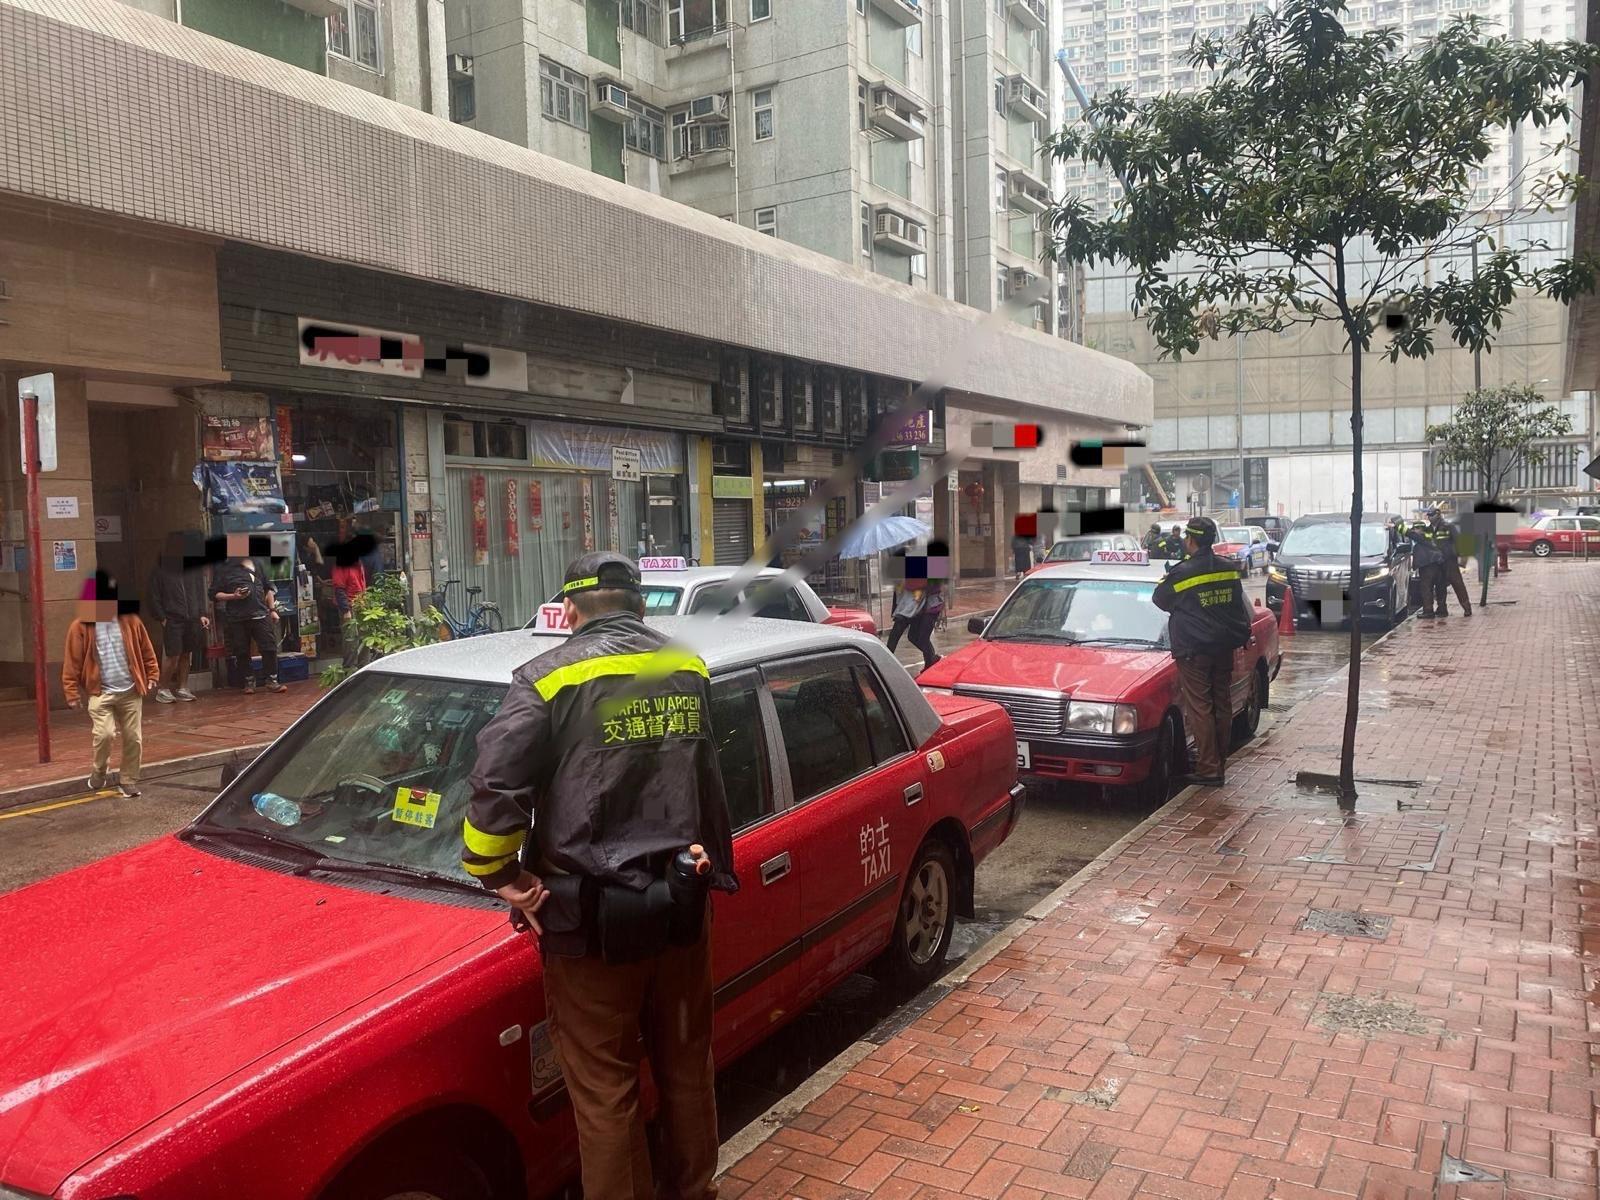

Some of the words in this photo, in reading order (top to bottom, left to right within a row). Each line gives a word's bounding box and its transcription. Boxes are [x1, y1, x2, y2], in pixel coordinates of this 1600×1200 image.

[641, 558, 678, 569] TAXI
[1097, 551, 1143, 562] TAXI
[654, 695, 701, 712] WARDEN
[602, 711, 701, 743] 交通督導員
[860, 816, 890, 856] 的士
[861, 844, 891, 887] TAXI
